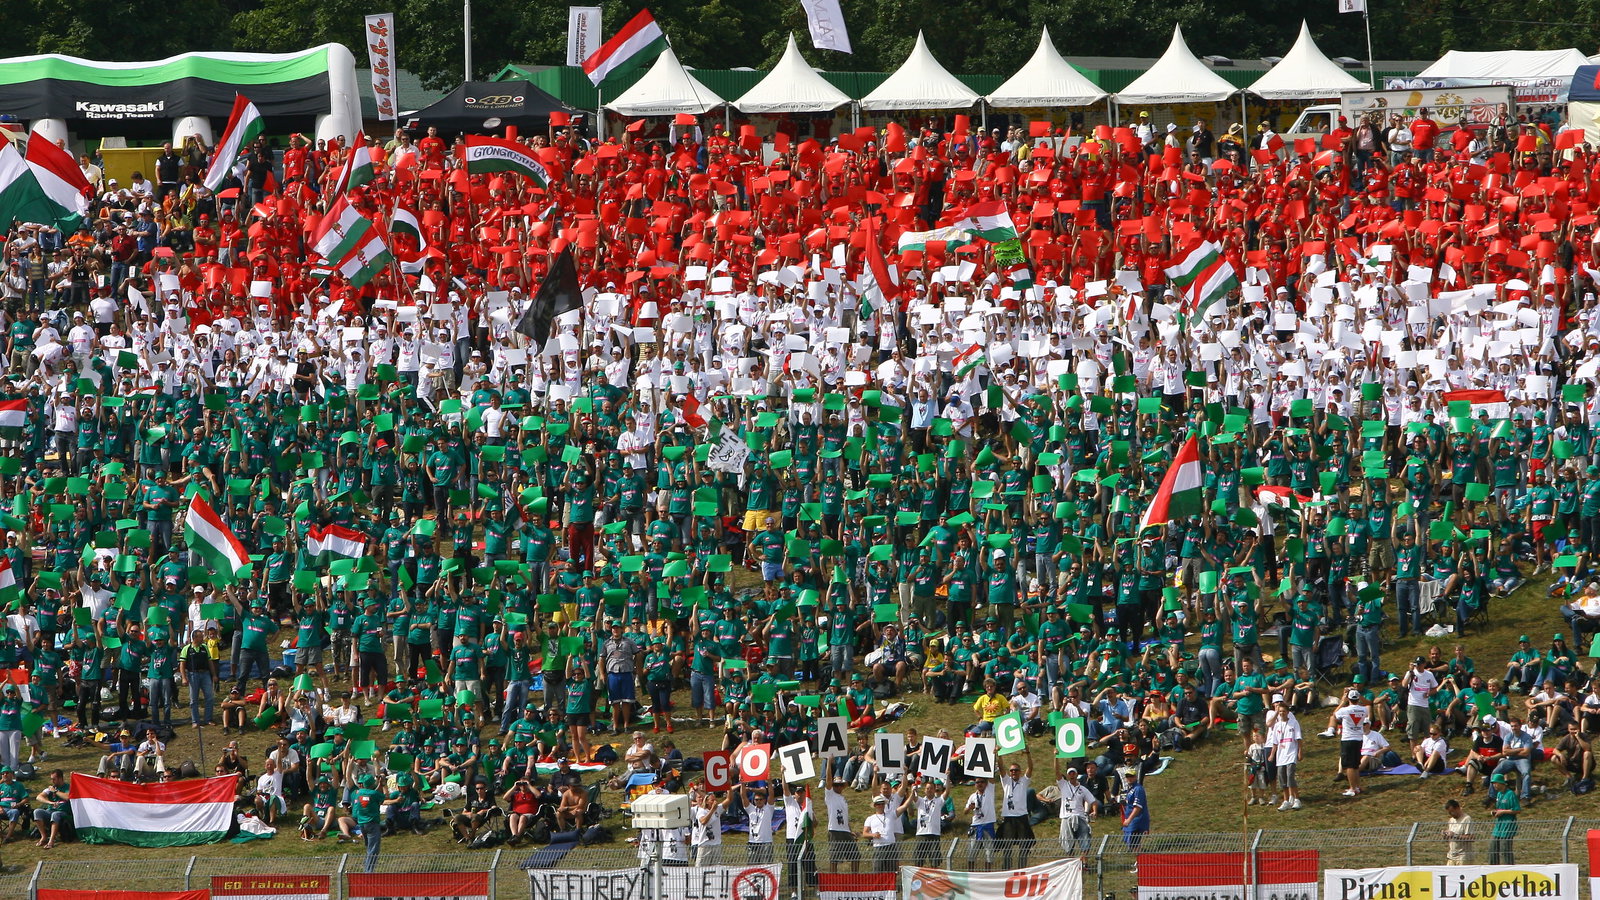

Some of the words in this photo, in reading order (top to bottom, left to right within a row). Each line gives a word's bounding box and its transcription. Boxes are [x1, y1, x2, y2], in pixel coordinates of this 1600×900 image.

[1535, 77, 1564, 88] Prix
[76, 101, 164, 112] Kawasaki
[224, 881, 242, 890] GO
[250, 880, 294, 889] Talma
[1341, 877, 1411, 900] Pirna
[1439, 873, 1561, 899] Liebethal
